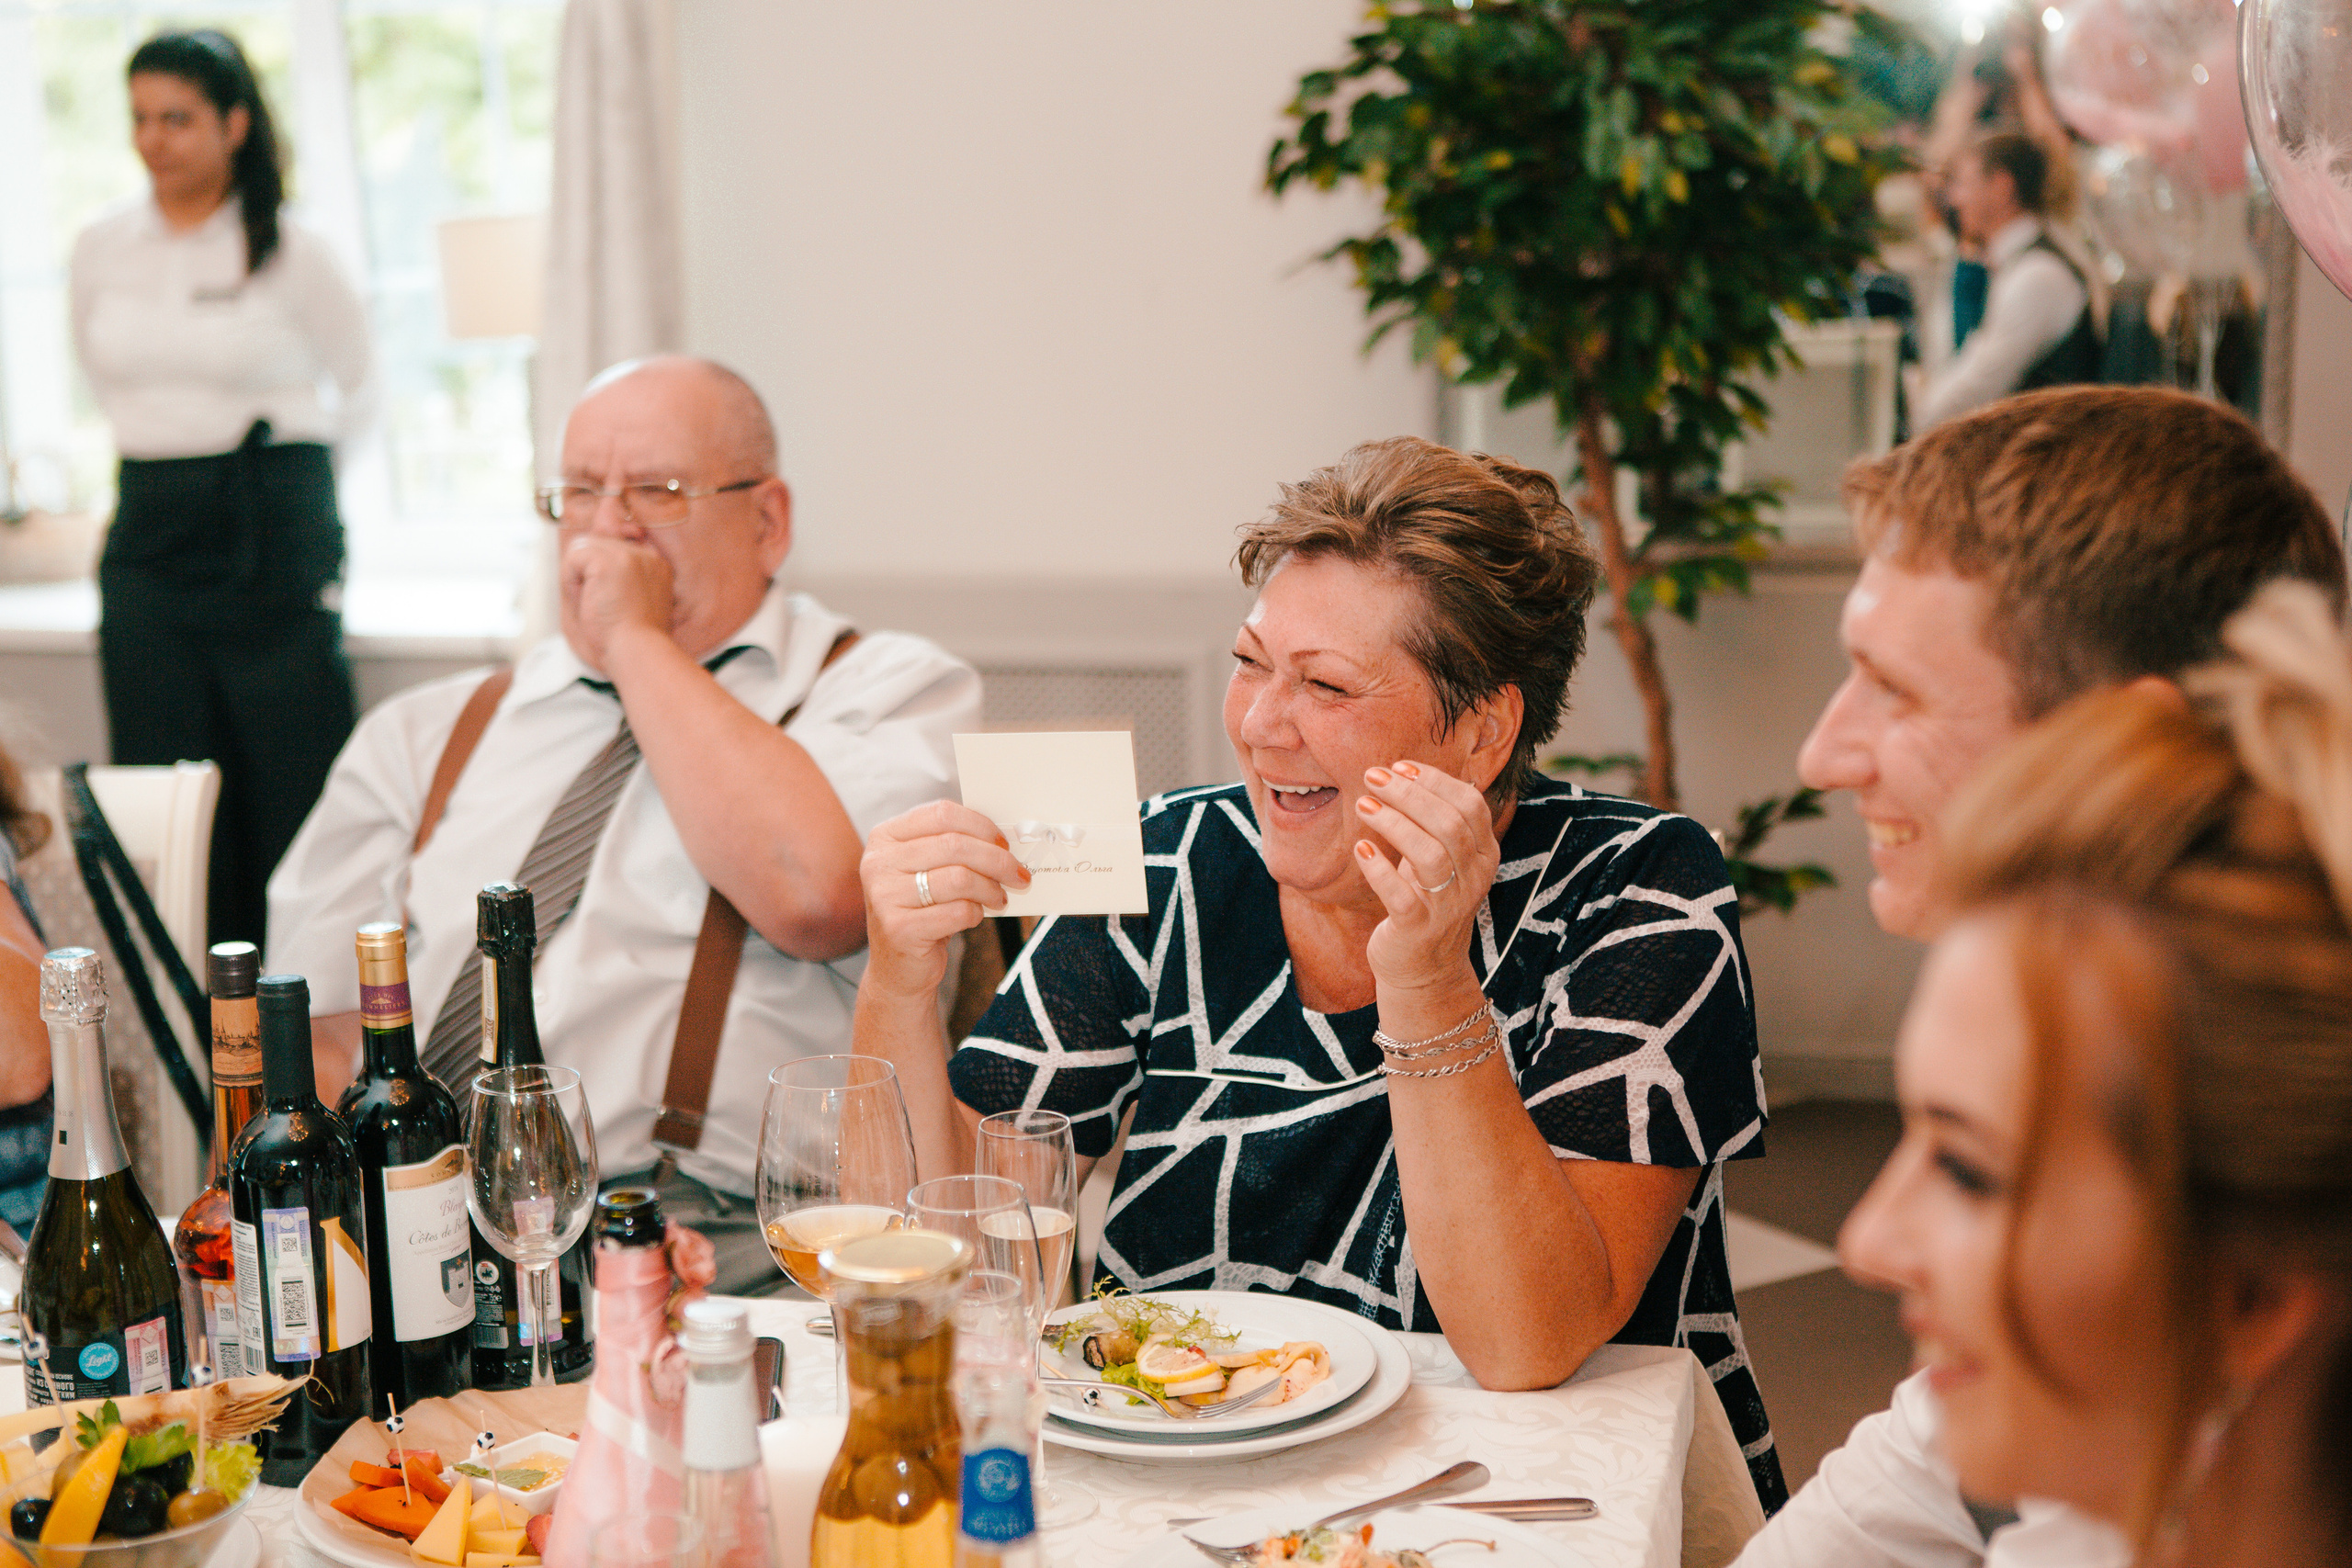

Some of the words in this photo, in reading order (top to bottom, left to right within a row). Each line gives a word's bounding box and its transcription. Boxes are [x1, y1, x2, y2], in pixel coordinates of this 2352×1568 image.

[1074, 861, 1114, 873] Ольга
[409, 1230, 438, 1246] Côtes
[441, 1224, 451, 1239] de
